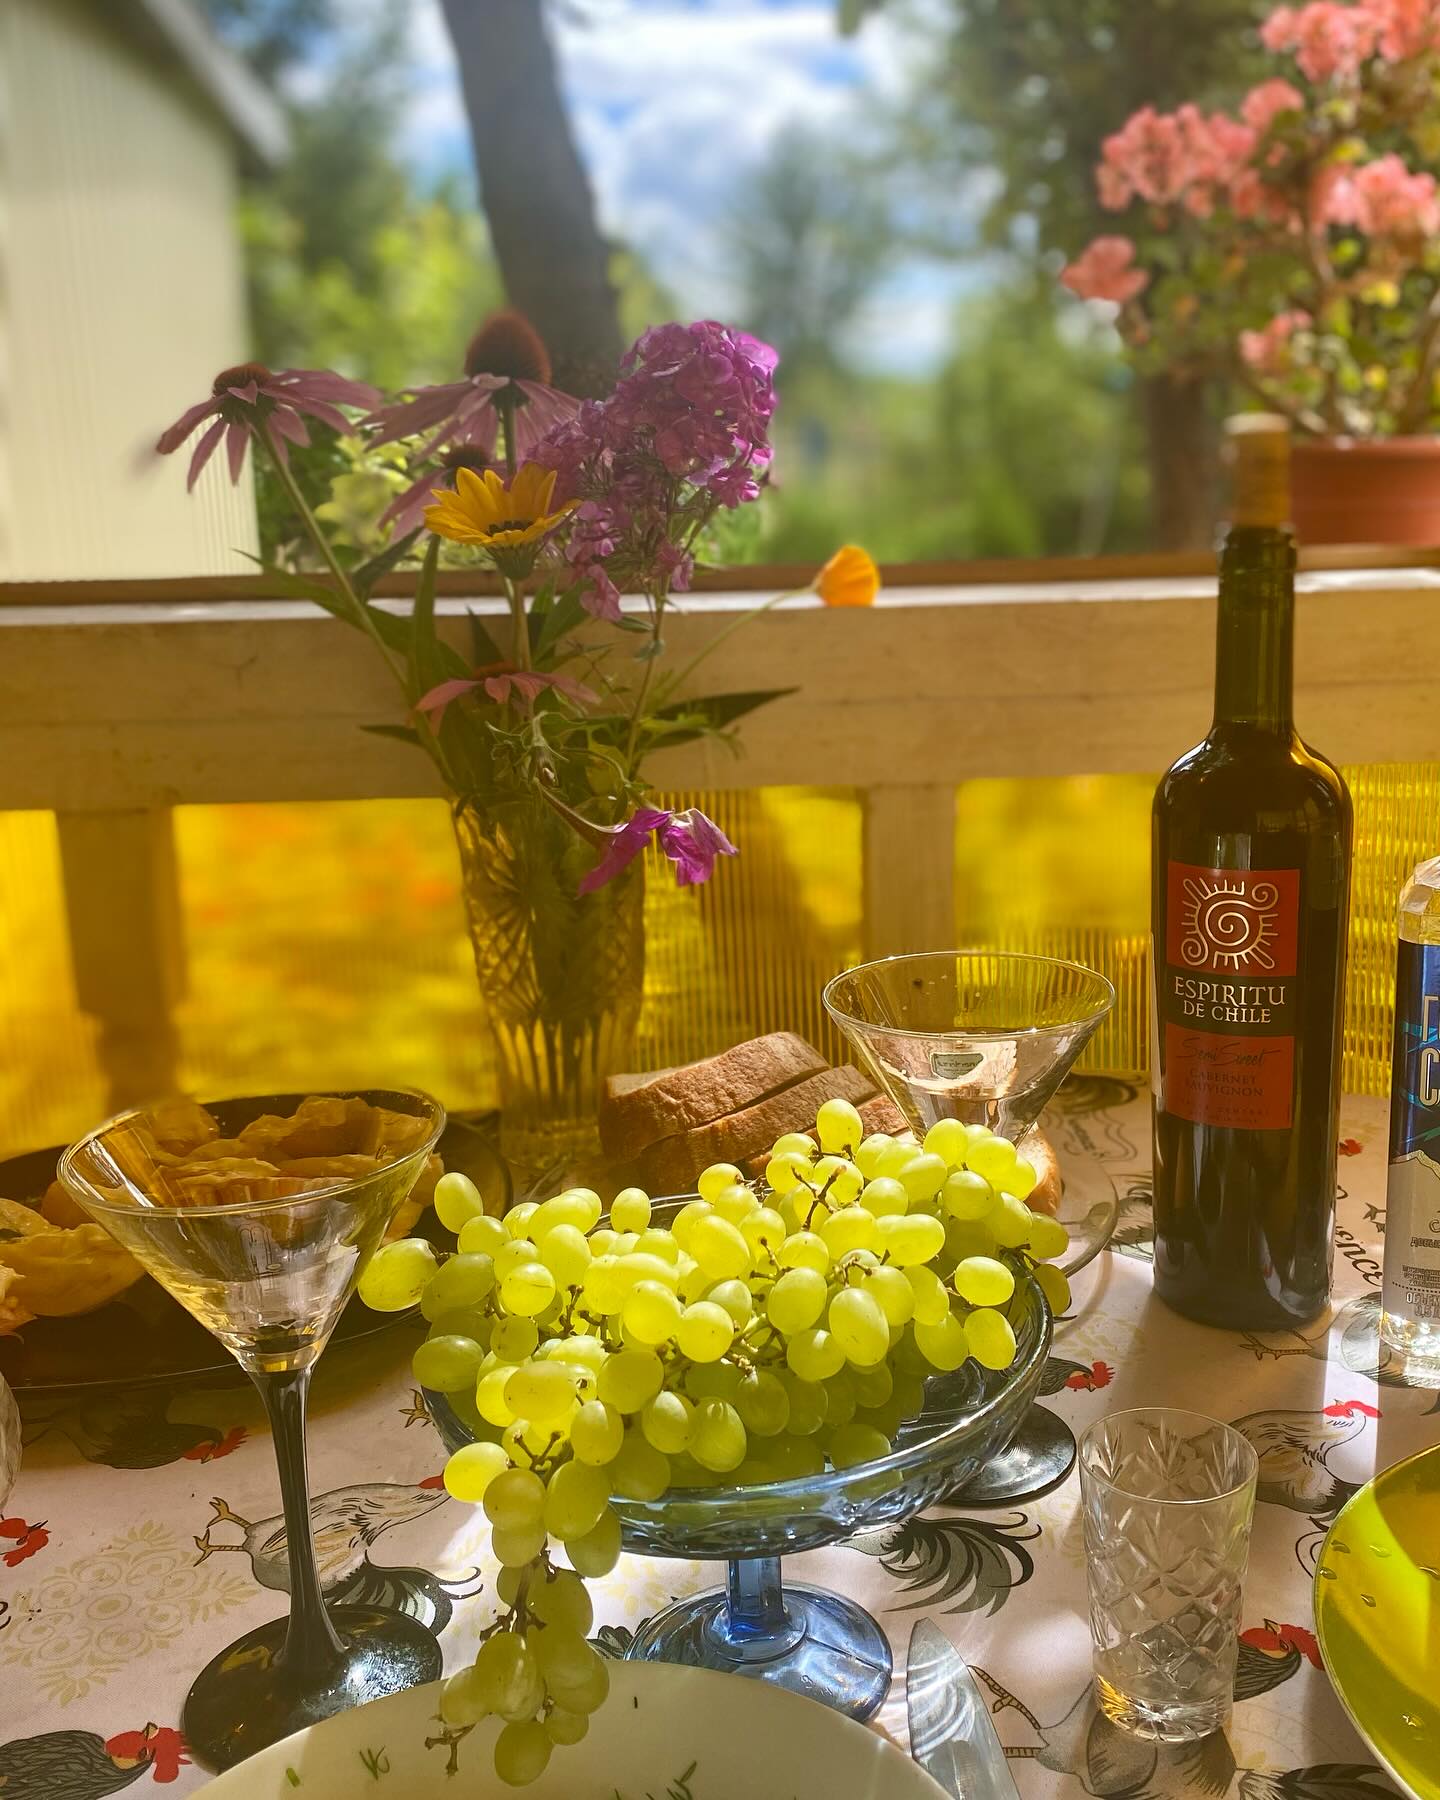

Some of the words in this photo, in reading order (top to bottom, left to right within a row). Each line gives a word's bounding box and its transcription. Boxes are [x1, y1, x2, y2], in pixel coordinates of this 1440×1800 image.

[1174, 976, 1286, 1008] ESPIRITU
[1183, 1000, 1205, 1018] DE
[1211, 1005, 1271, 1024] CHILE
[1176, 1037, 1218, 1061] Semi
[1210, 1042, 1281, 1066] Sweet
